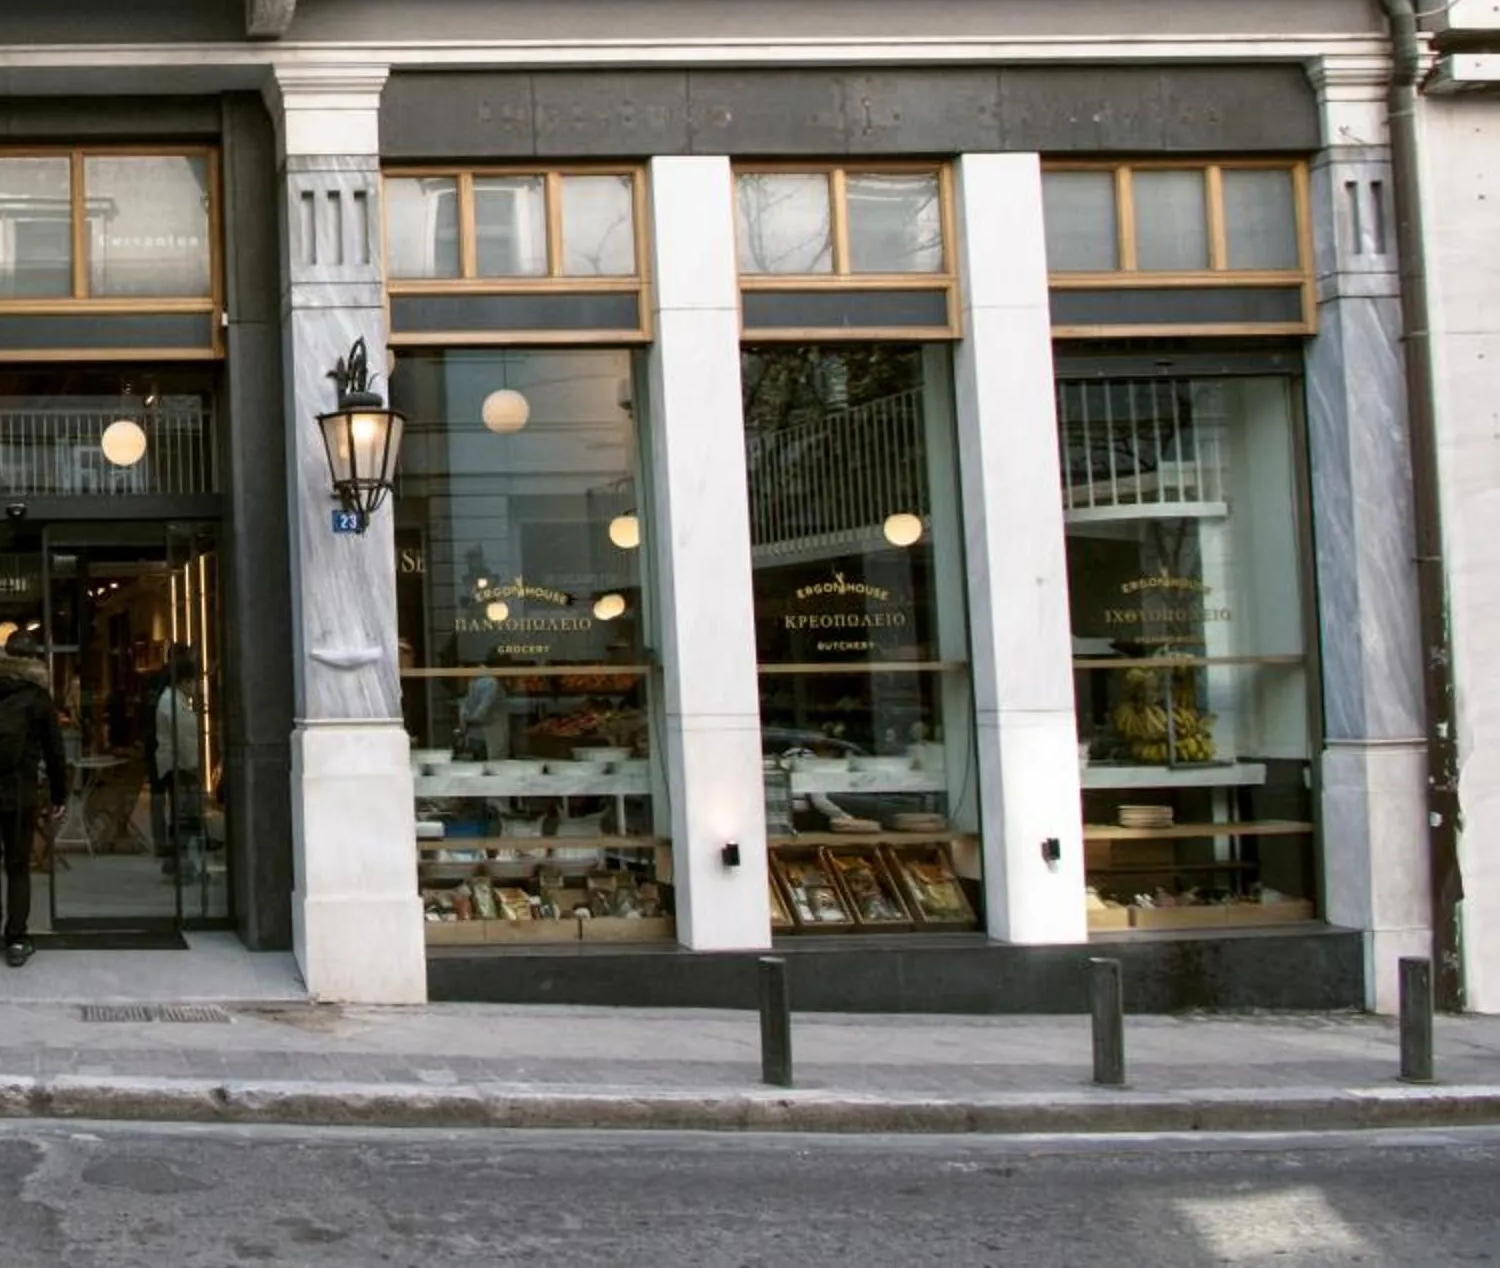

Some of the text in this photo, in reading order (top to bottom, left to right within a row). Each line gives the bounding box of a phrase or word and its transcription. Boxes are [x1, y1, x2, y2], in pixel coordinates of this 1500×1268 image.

[341, 514, 357, 528] 23
[473, 586, 567, 605] ERGON HOUSE
[796, 582, 889, 601] ERGON HOUSE
[785, 612, 905, 629] ΚΡΕΟΠΩΛΕΙΟ
[817, 640, 875, 651] BUTCHERY
